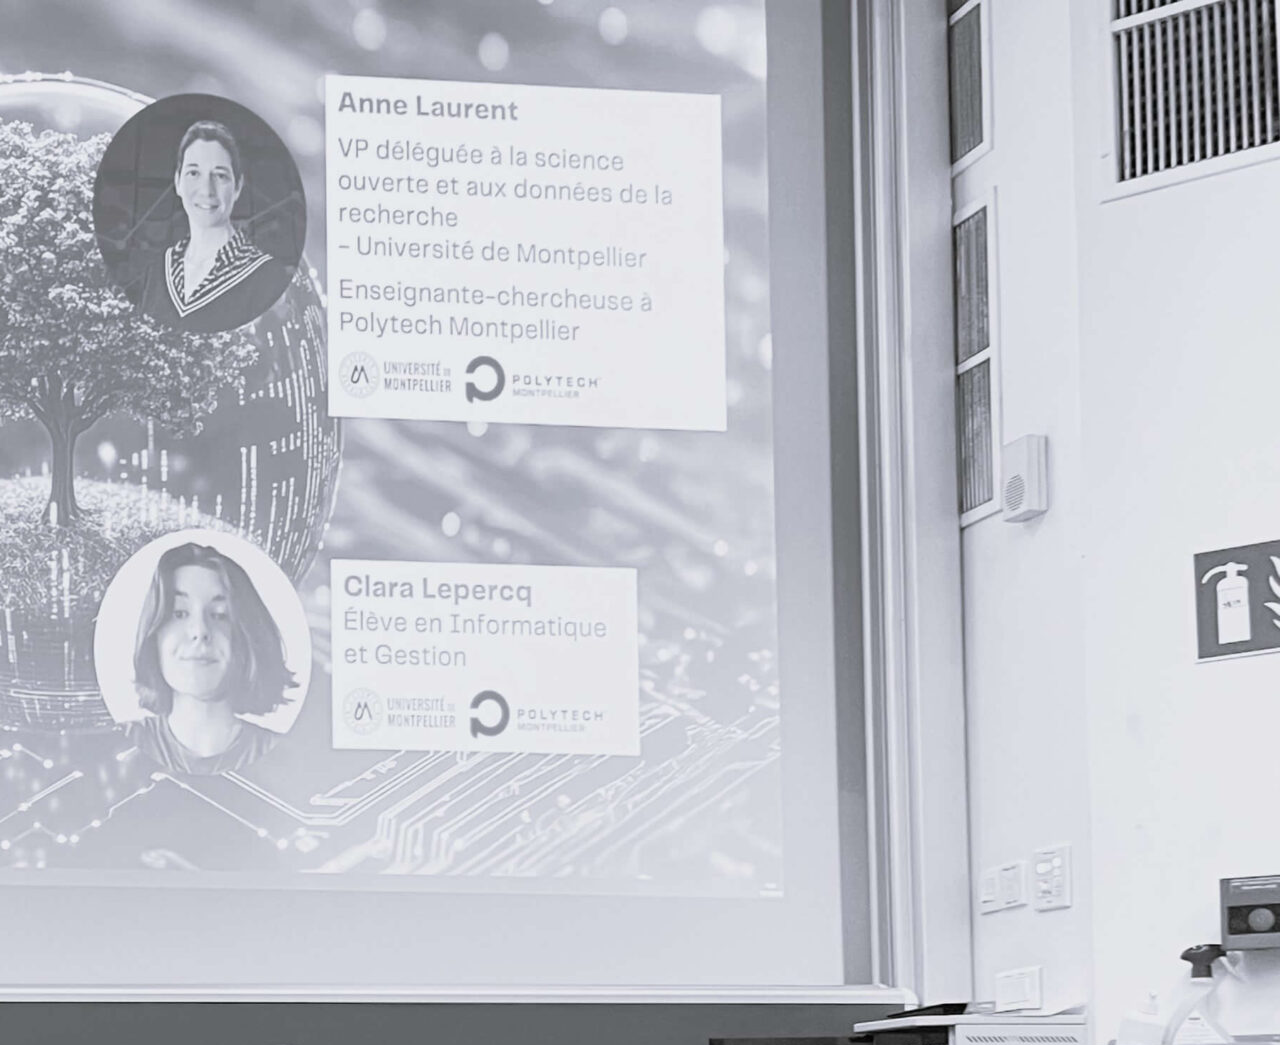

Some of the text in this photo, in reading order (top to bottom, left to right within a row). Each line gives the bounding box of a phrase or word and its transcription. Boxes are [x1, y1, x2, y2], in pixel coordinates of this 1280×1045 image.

[339, 92, 518, 120] Anne Laurent
[338, 138, 623, 171] VP déléguée à la science
[339, 175, 672, 205] ouverte et aux données de la
[338, 204, 458, 227] recherche
[357, 236, 474, 260] Université
[482, 241, 509, 262] de
[518, 243, 647, 270] Montpellier
[339, 279, 652, 312] Enseignante-chercheuse à
[341, 312, 580, 343] Polytech Montpellier
[384, 361, 442, 376] UNIVERSITÉ
[512, 375, 598, 387] POLYTECH
[384, 378, 451, 392] MONTPELLIER
[344, 575, 531, 607] Clara Lepercq
[344, 607, 606, 641] Élève en Informatique
[345, 644, 466, 666] et Gestion
[387, 696, 446, 711] UNIVERSITÉ
[517, 709, 603, 721] POLYTECH
[388, 714, 456, 728] MONTPELLIER
